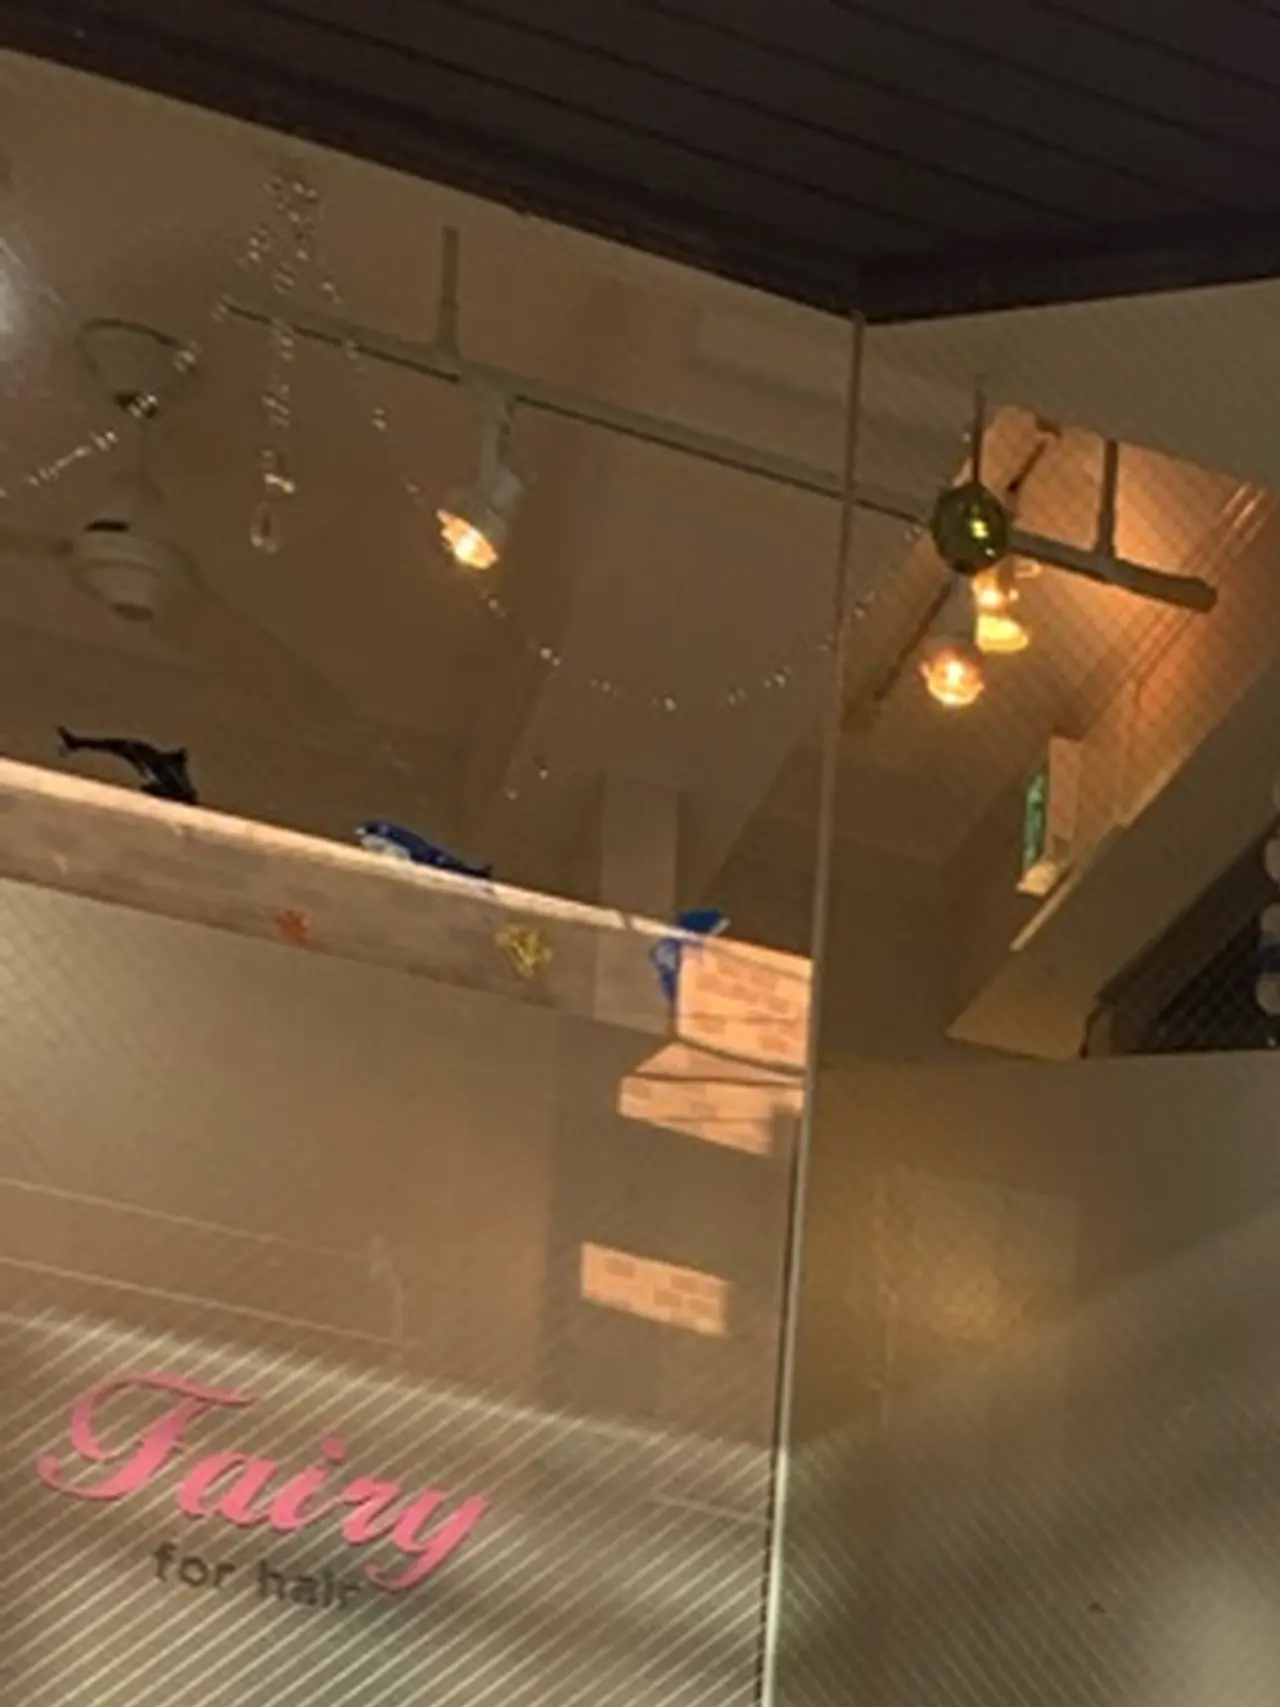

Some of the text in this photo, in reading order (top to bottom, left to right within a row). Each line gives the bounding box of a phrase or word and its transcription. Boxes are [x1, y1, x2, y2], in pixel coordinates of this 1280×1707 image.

[36, 1370, 491, 1596] Fairy
[153, 1541, 363, 1611] for hair
